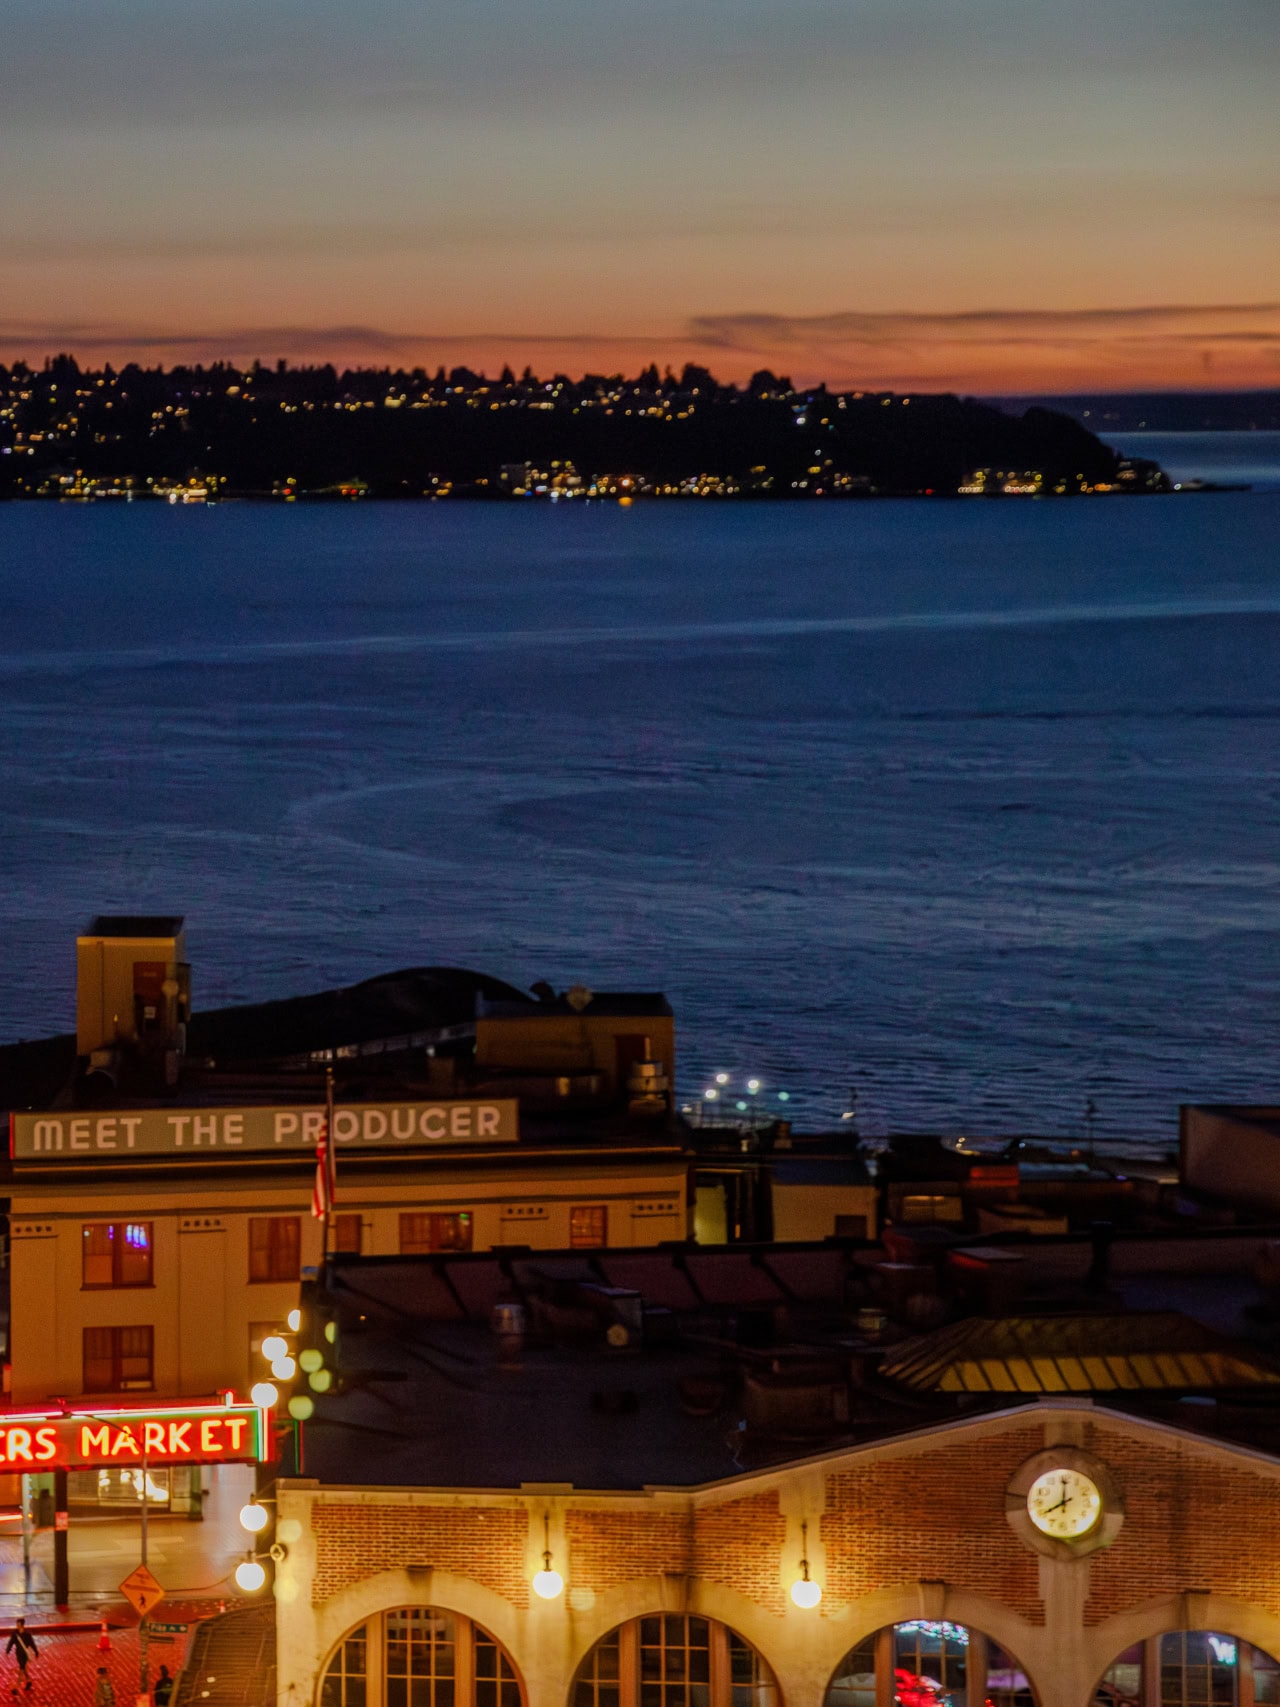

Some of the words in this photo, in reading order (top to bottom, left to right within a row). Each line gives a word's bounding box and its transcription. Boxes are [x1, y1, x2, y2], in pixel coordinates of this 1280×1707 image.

[33, 1117, 142, 1151] MEET
[167, 1114, 244, 1146] THE
[274, 1105, 501, 1143] PRODUCER
[81, 1418, 248, 1457] MARKET
